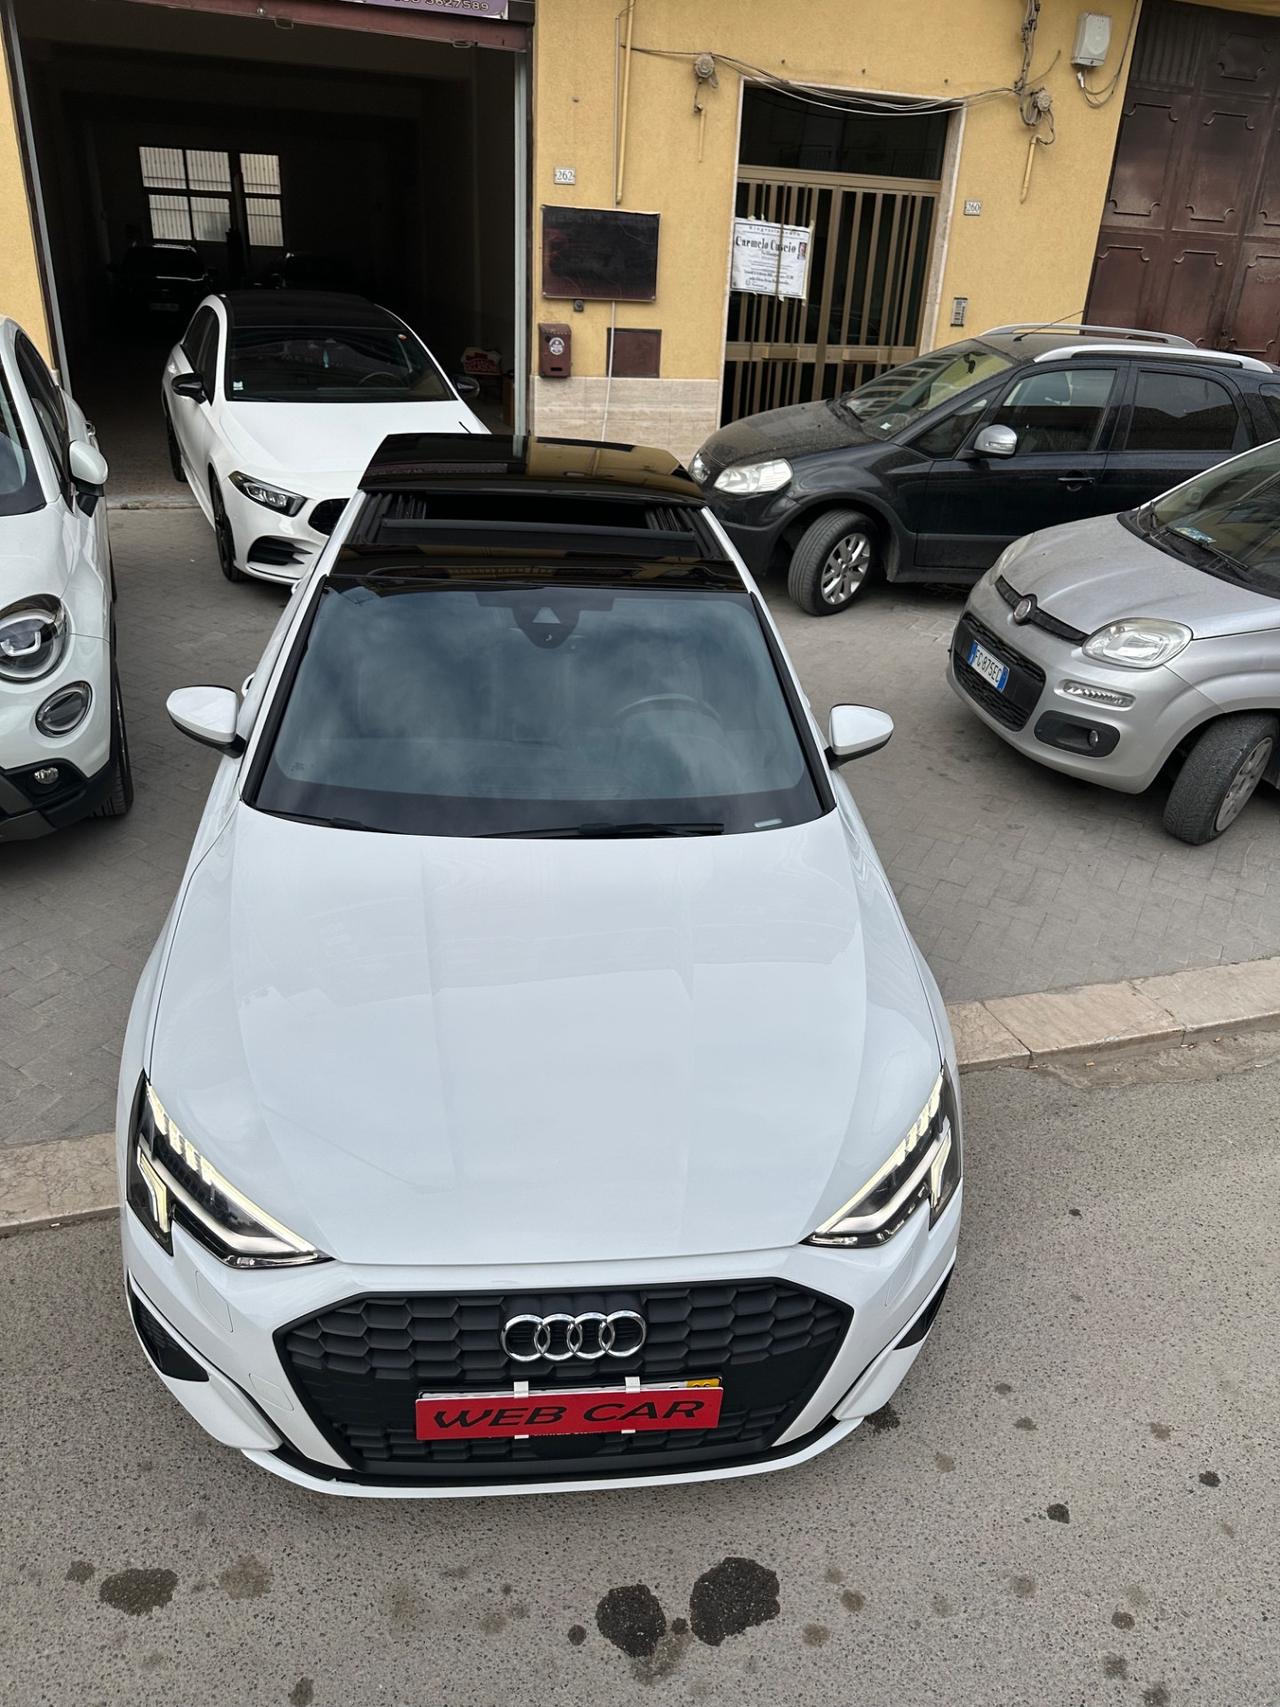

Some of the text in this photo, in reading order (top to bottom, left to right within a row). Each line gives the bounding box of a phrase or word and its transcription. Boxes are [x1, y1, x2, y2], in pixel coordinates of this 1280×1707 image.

[557, 170, 574, 181] 262
[735, 236, 769, 250] Carmelo
[433, 1400, 704, 1429] WEB CAR
